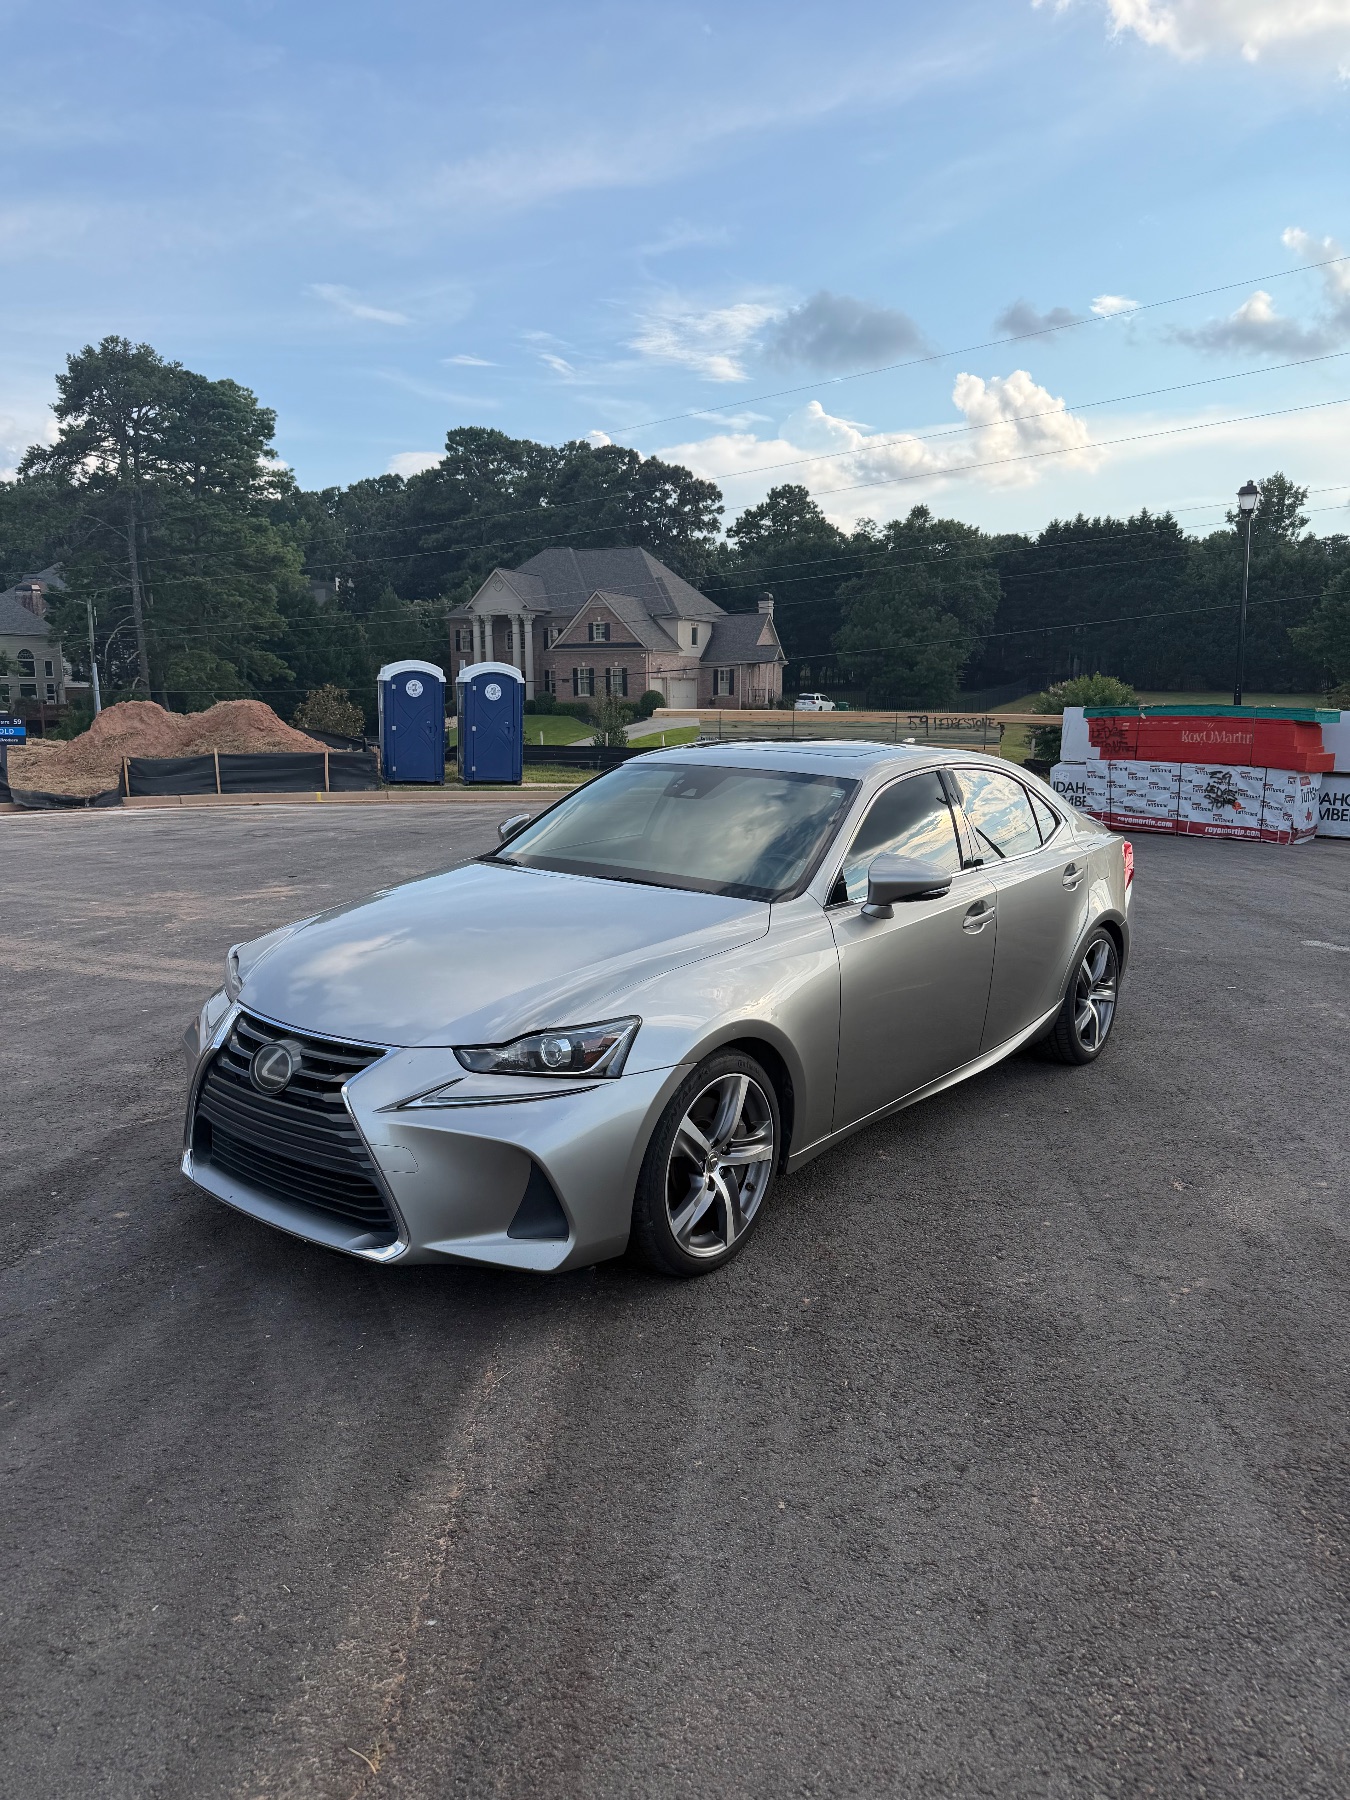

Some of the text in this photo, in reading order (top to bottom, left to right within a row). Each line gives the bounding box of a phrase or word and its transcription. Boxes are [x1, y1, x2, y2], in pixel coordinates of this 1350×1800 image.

[907, 715, 929, 736] 59
[1053, 781, 1086, 794] IDAH
[1319, 807, 1350, 821] MBE
